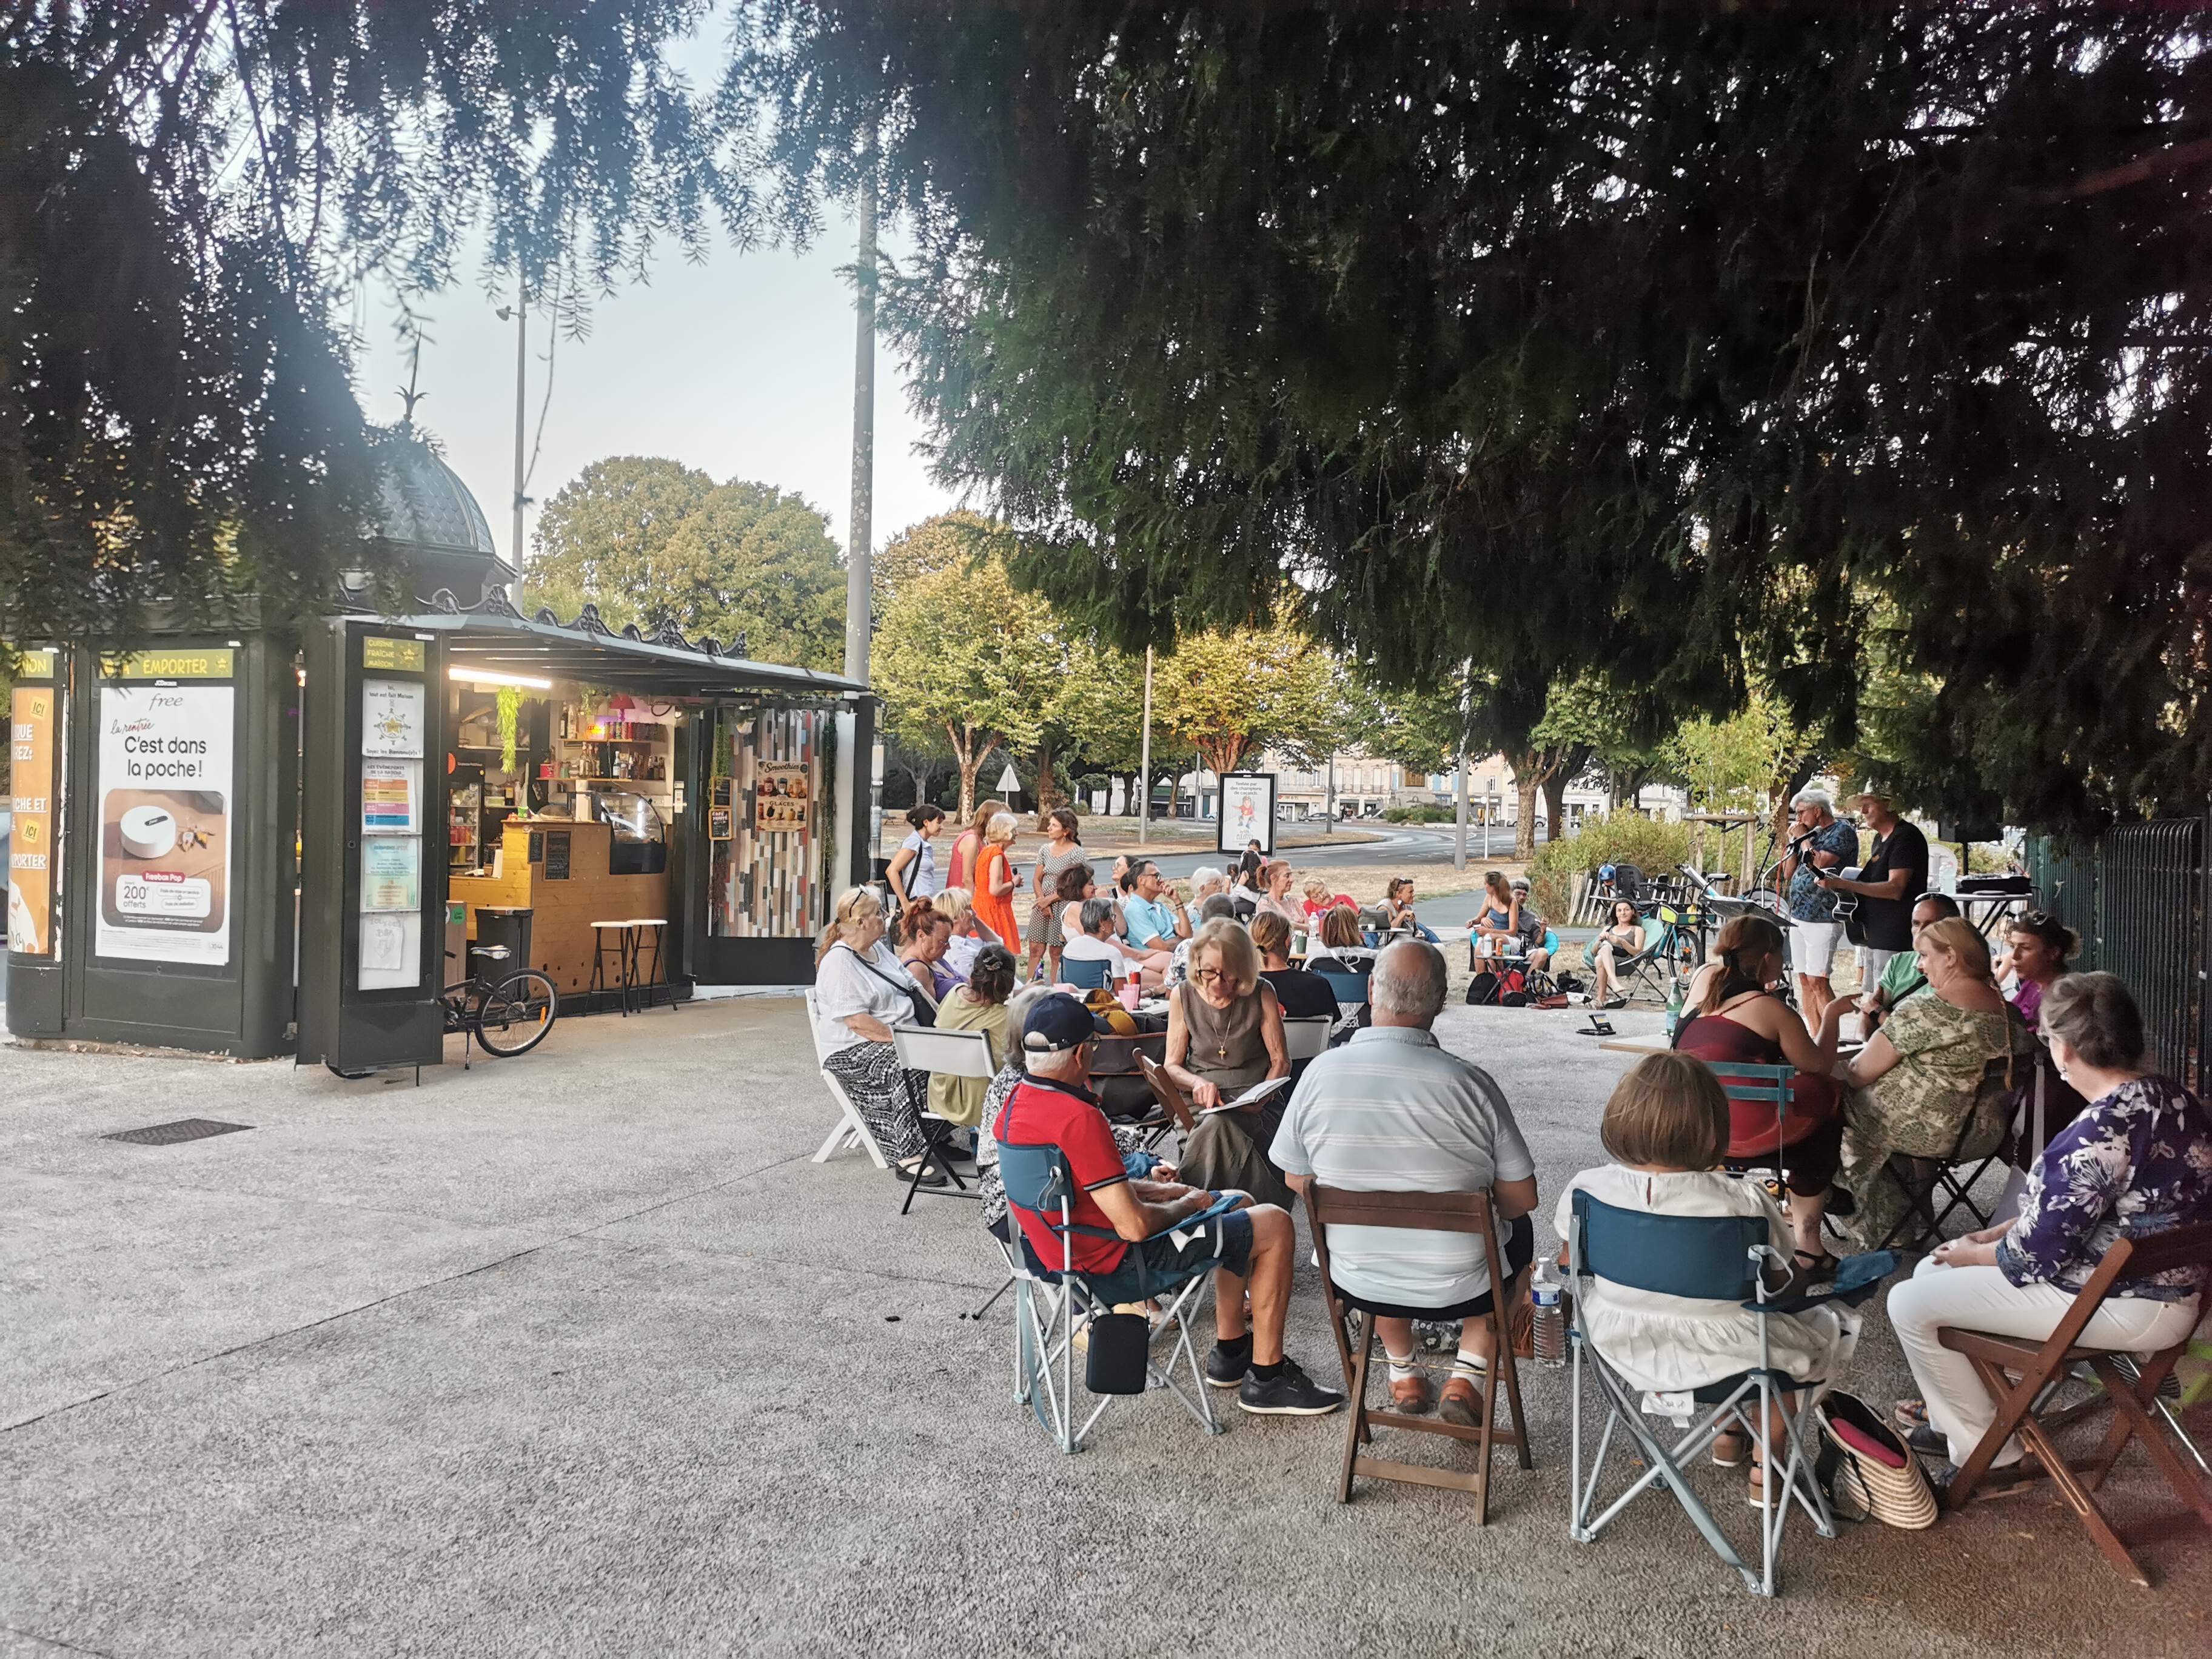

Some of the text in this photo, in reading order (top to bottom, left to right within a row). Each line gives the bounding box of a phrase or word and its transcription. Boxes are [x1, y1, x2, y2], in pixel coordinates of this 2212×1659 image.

[143, 659, 207, 674] EMPORTER
[33, 702, 45, 715] ICI
[149, 693, 183, 711] free
[110, 718, 155, 735] la rentrée
[124, 736, 207, 754] C'est dans
[127, 759, 141, 776] la
[764, 762, 800, 773] Smoothies
[34, 798, 47, 810] ET
[25, 825, 37, 837] ICI
[146, 873, 183, 883] Freebox Pop
[123, 900, 146, 909] offerts
